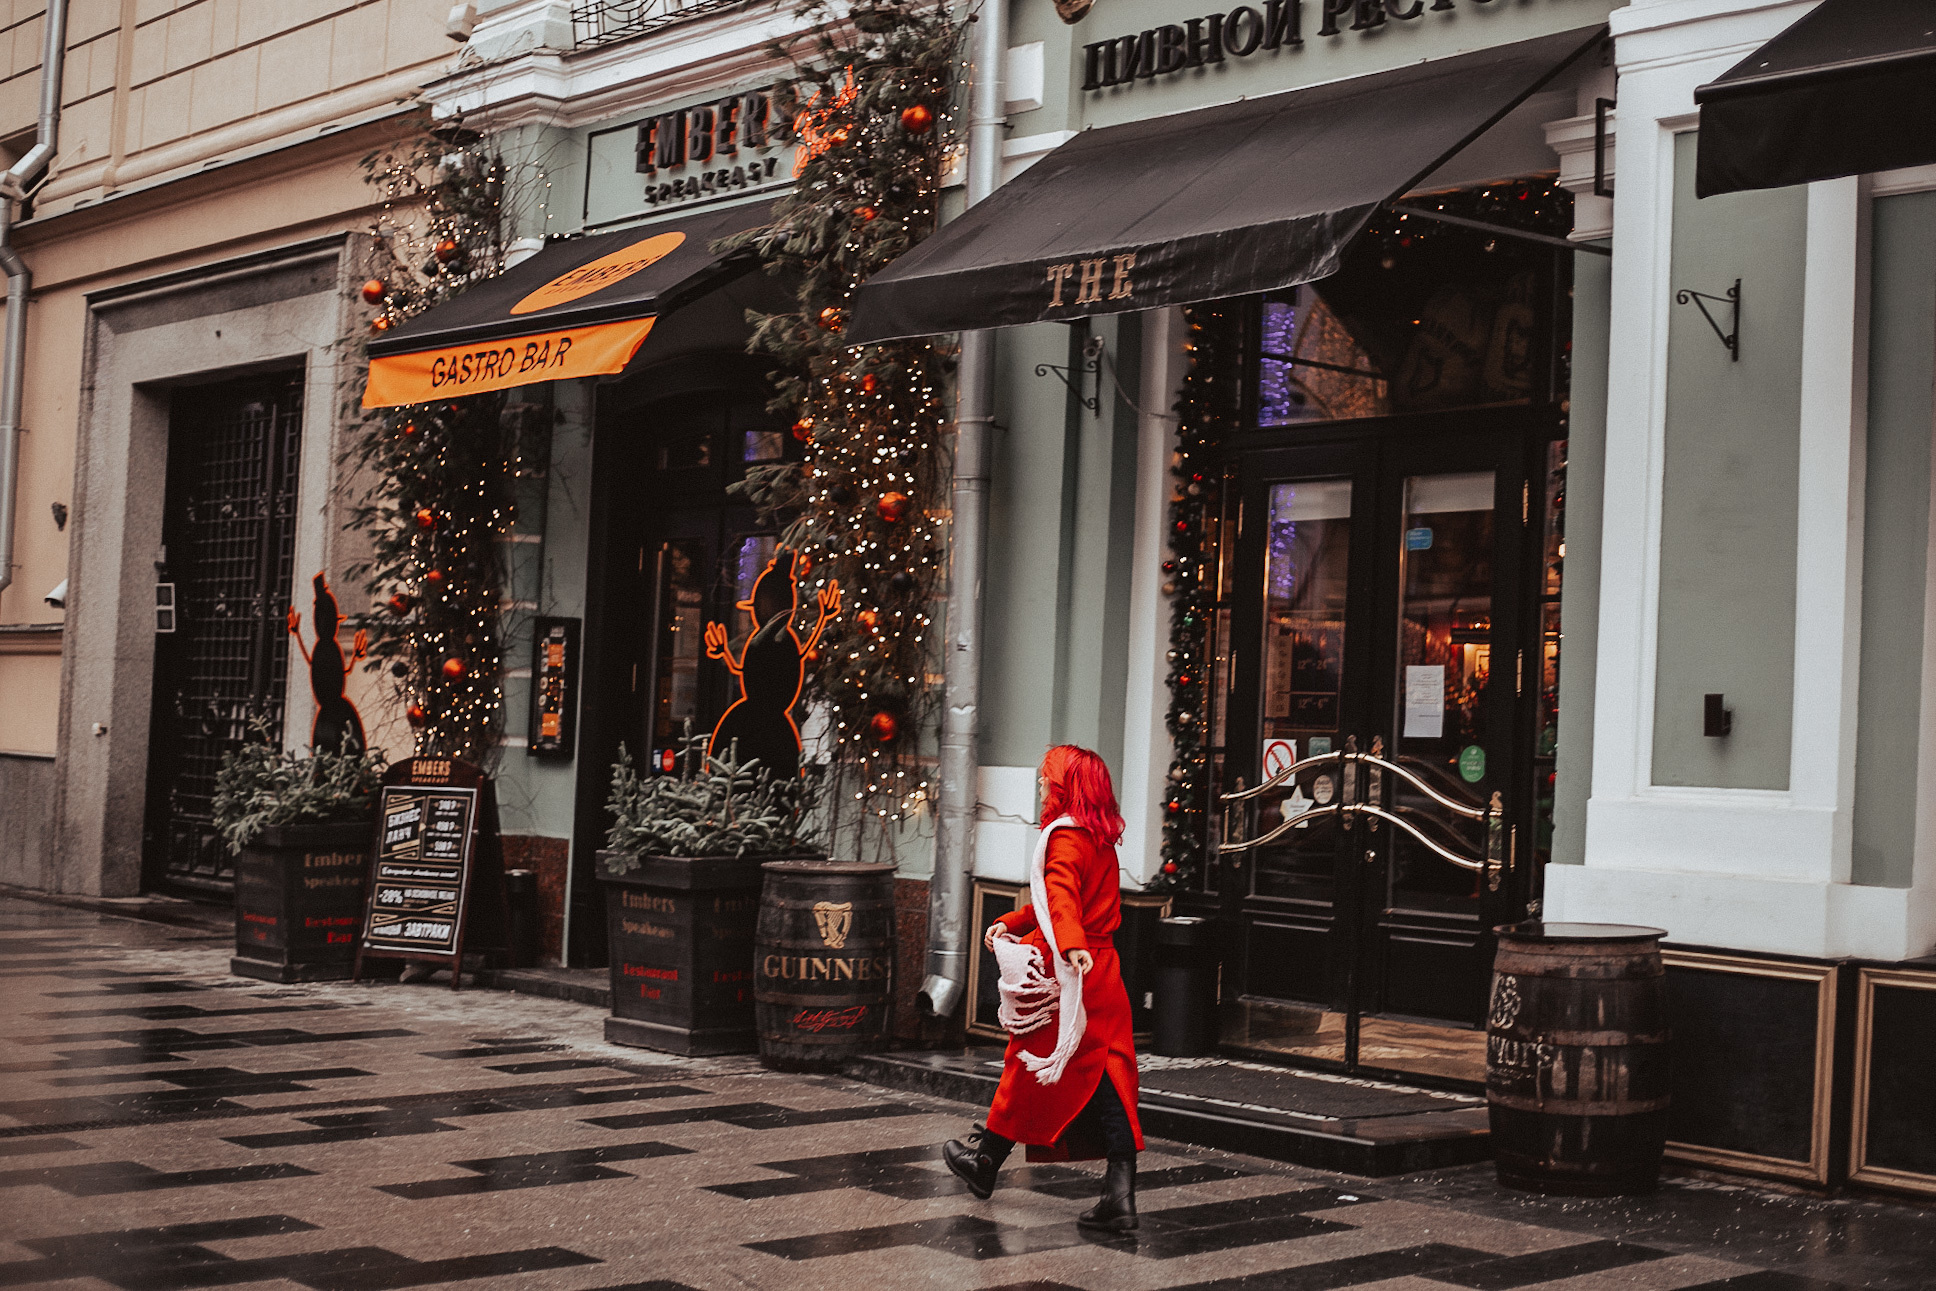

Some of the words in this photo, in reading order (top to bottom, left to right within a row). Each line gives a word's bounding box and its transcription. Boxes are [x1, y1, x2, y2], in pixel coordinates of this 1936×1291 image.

[644, 157, 778, 205] SPEAKEASY
[1046, 253, 1137, 308] THE
[431, 347, 515, 389] GASTRO
[518, 337, 573, 374] BAR
[411, 760, 451, 776] EMBERS
